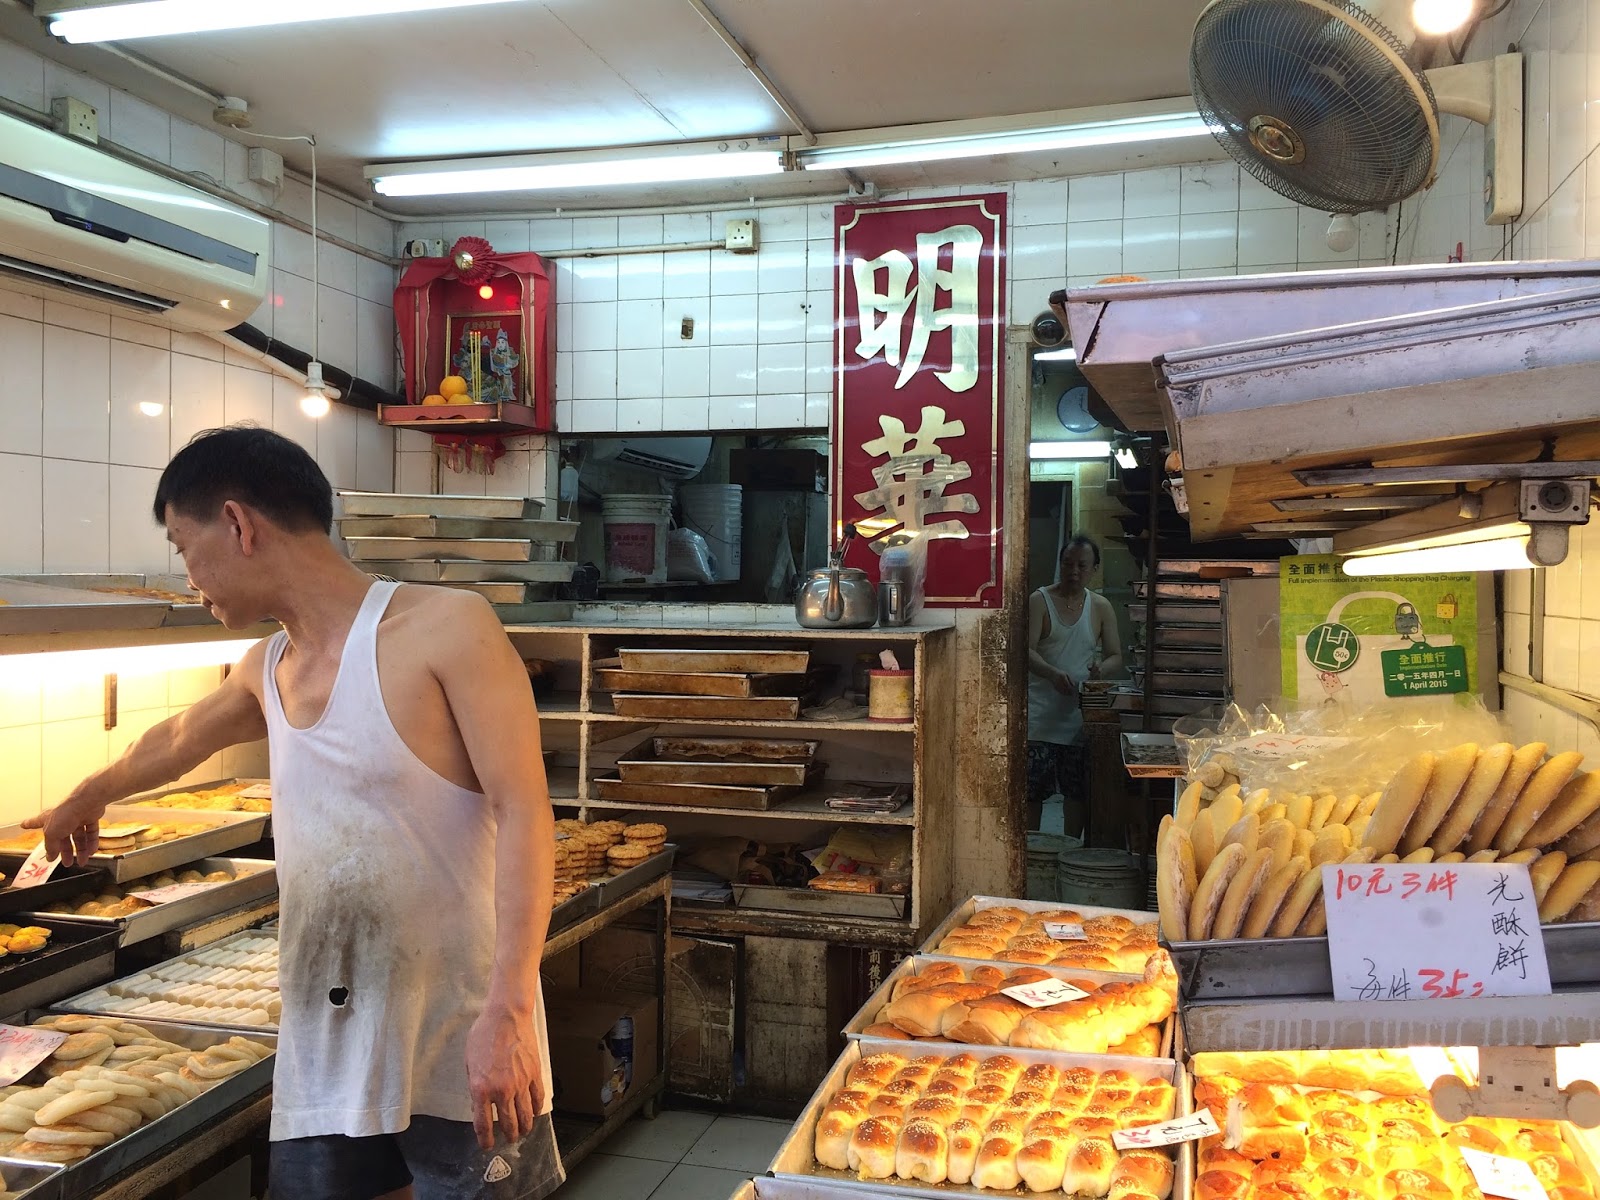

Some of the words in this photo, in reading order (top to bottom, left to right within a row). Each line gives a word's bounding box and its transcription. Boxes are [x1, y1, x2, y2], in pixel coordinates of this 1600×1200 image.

[853, 225, 983, 556] 明華
[1370, 575, 1392, 583] Plastic
[1393, 575, 1424, 583] Shopping
[1440, 574, 1471, 582] Charging
[1399, 652, 1446, 664] 全面推行
[1403, 682, 1408, 690] 1
[1410, 682, 1427, 690] April
[1429, 680, 1448, 688] 2015
